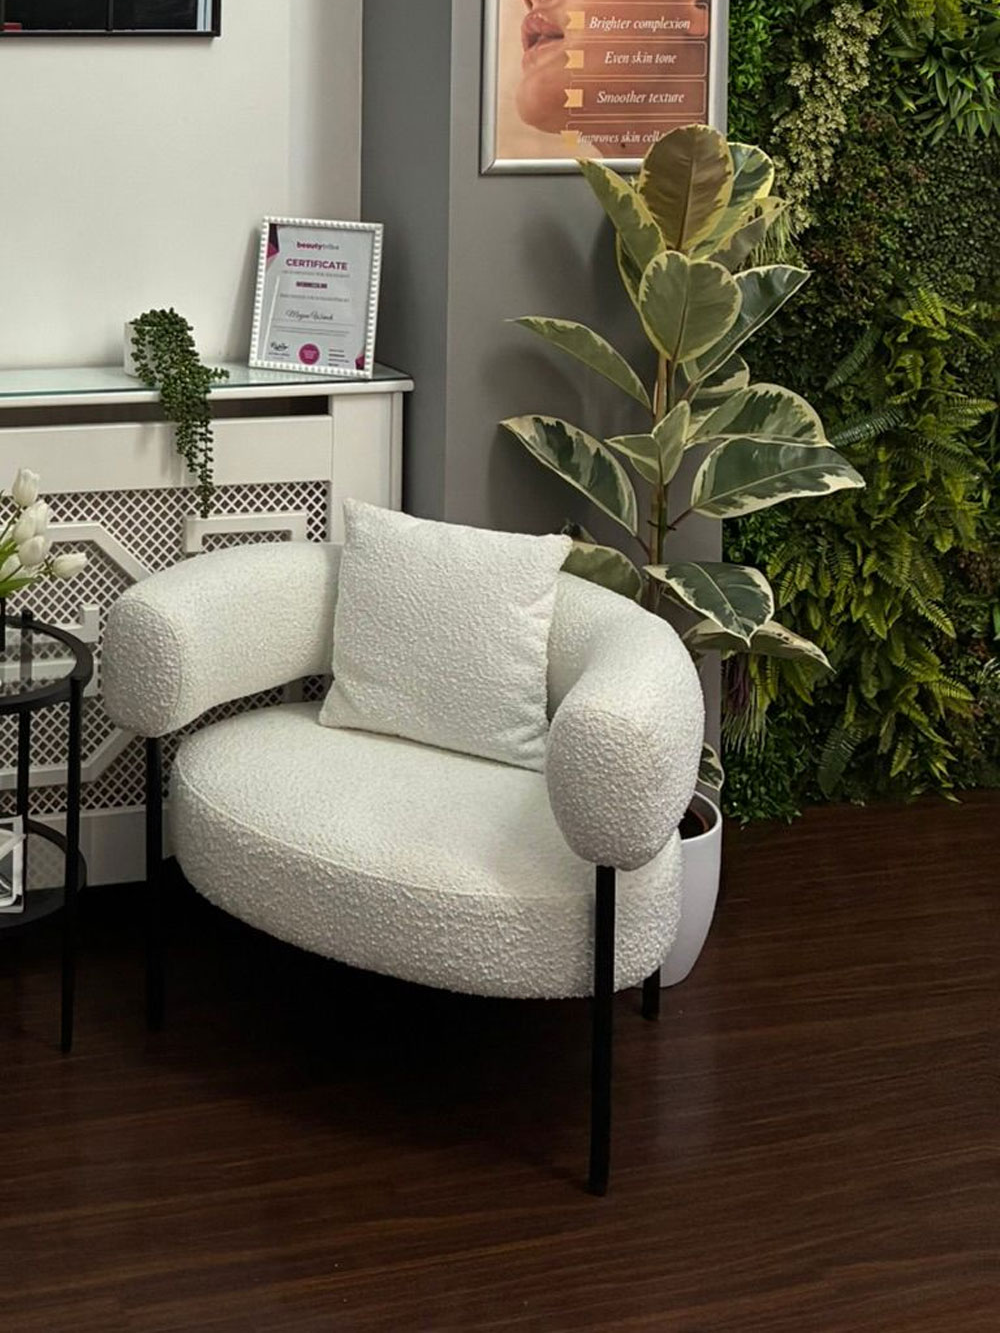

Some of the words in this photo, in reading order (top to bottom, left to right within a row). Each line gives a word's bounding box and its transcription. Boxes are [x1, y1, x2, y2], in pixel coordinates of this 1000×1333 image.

[589, 16, 632, 32] Brighter
[633, 17, 691, 32] complexion
[604, 51, 630, 64] Even
[631, 51, 653, 64] skin
[655, 52, 677, 64] tone
[597, 90, 646, 104] Smoother
[648, 92, 685, 104] texture
[621, 130, 641, 143] skin
[642, 130, 661, 143] cell
[285, 258, 348, 271] CERTIFICATE
